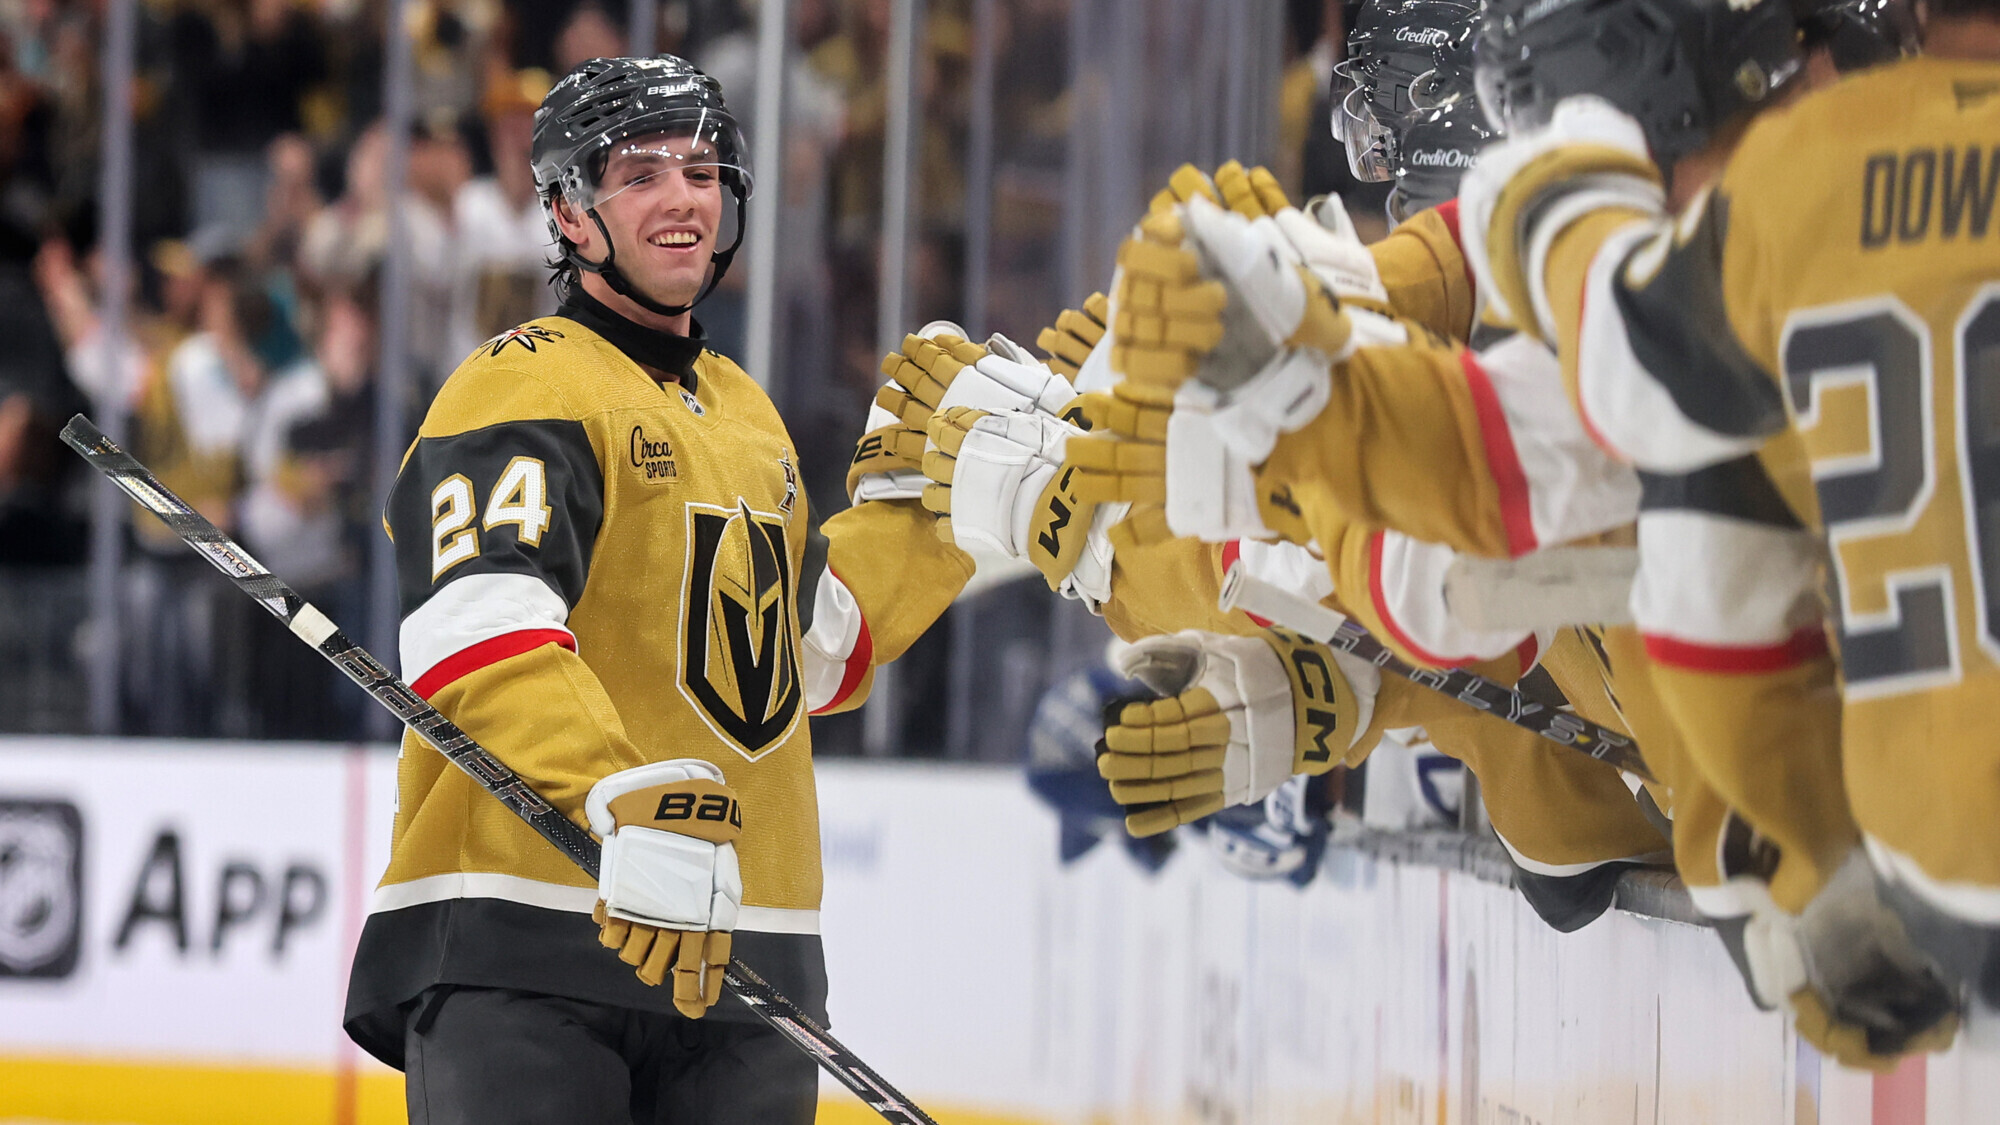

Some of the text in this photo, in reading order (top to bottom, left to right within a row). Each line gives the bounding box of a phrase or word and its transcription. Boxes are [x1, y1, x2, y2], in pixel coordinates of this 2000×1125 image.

[631, 425, 672, 467] Circa
[646, 460, 677, 479] SPORTS
[431, 455, 552, 585] 24
